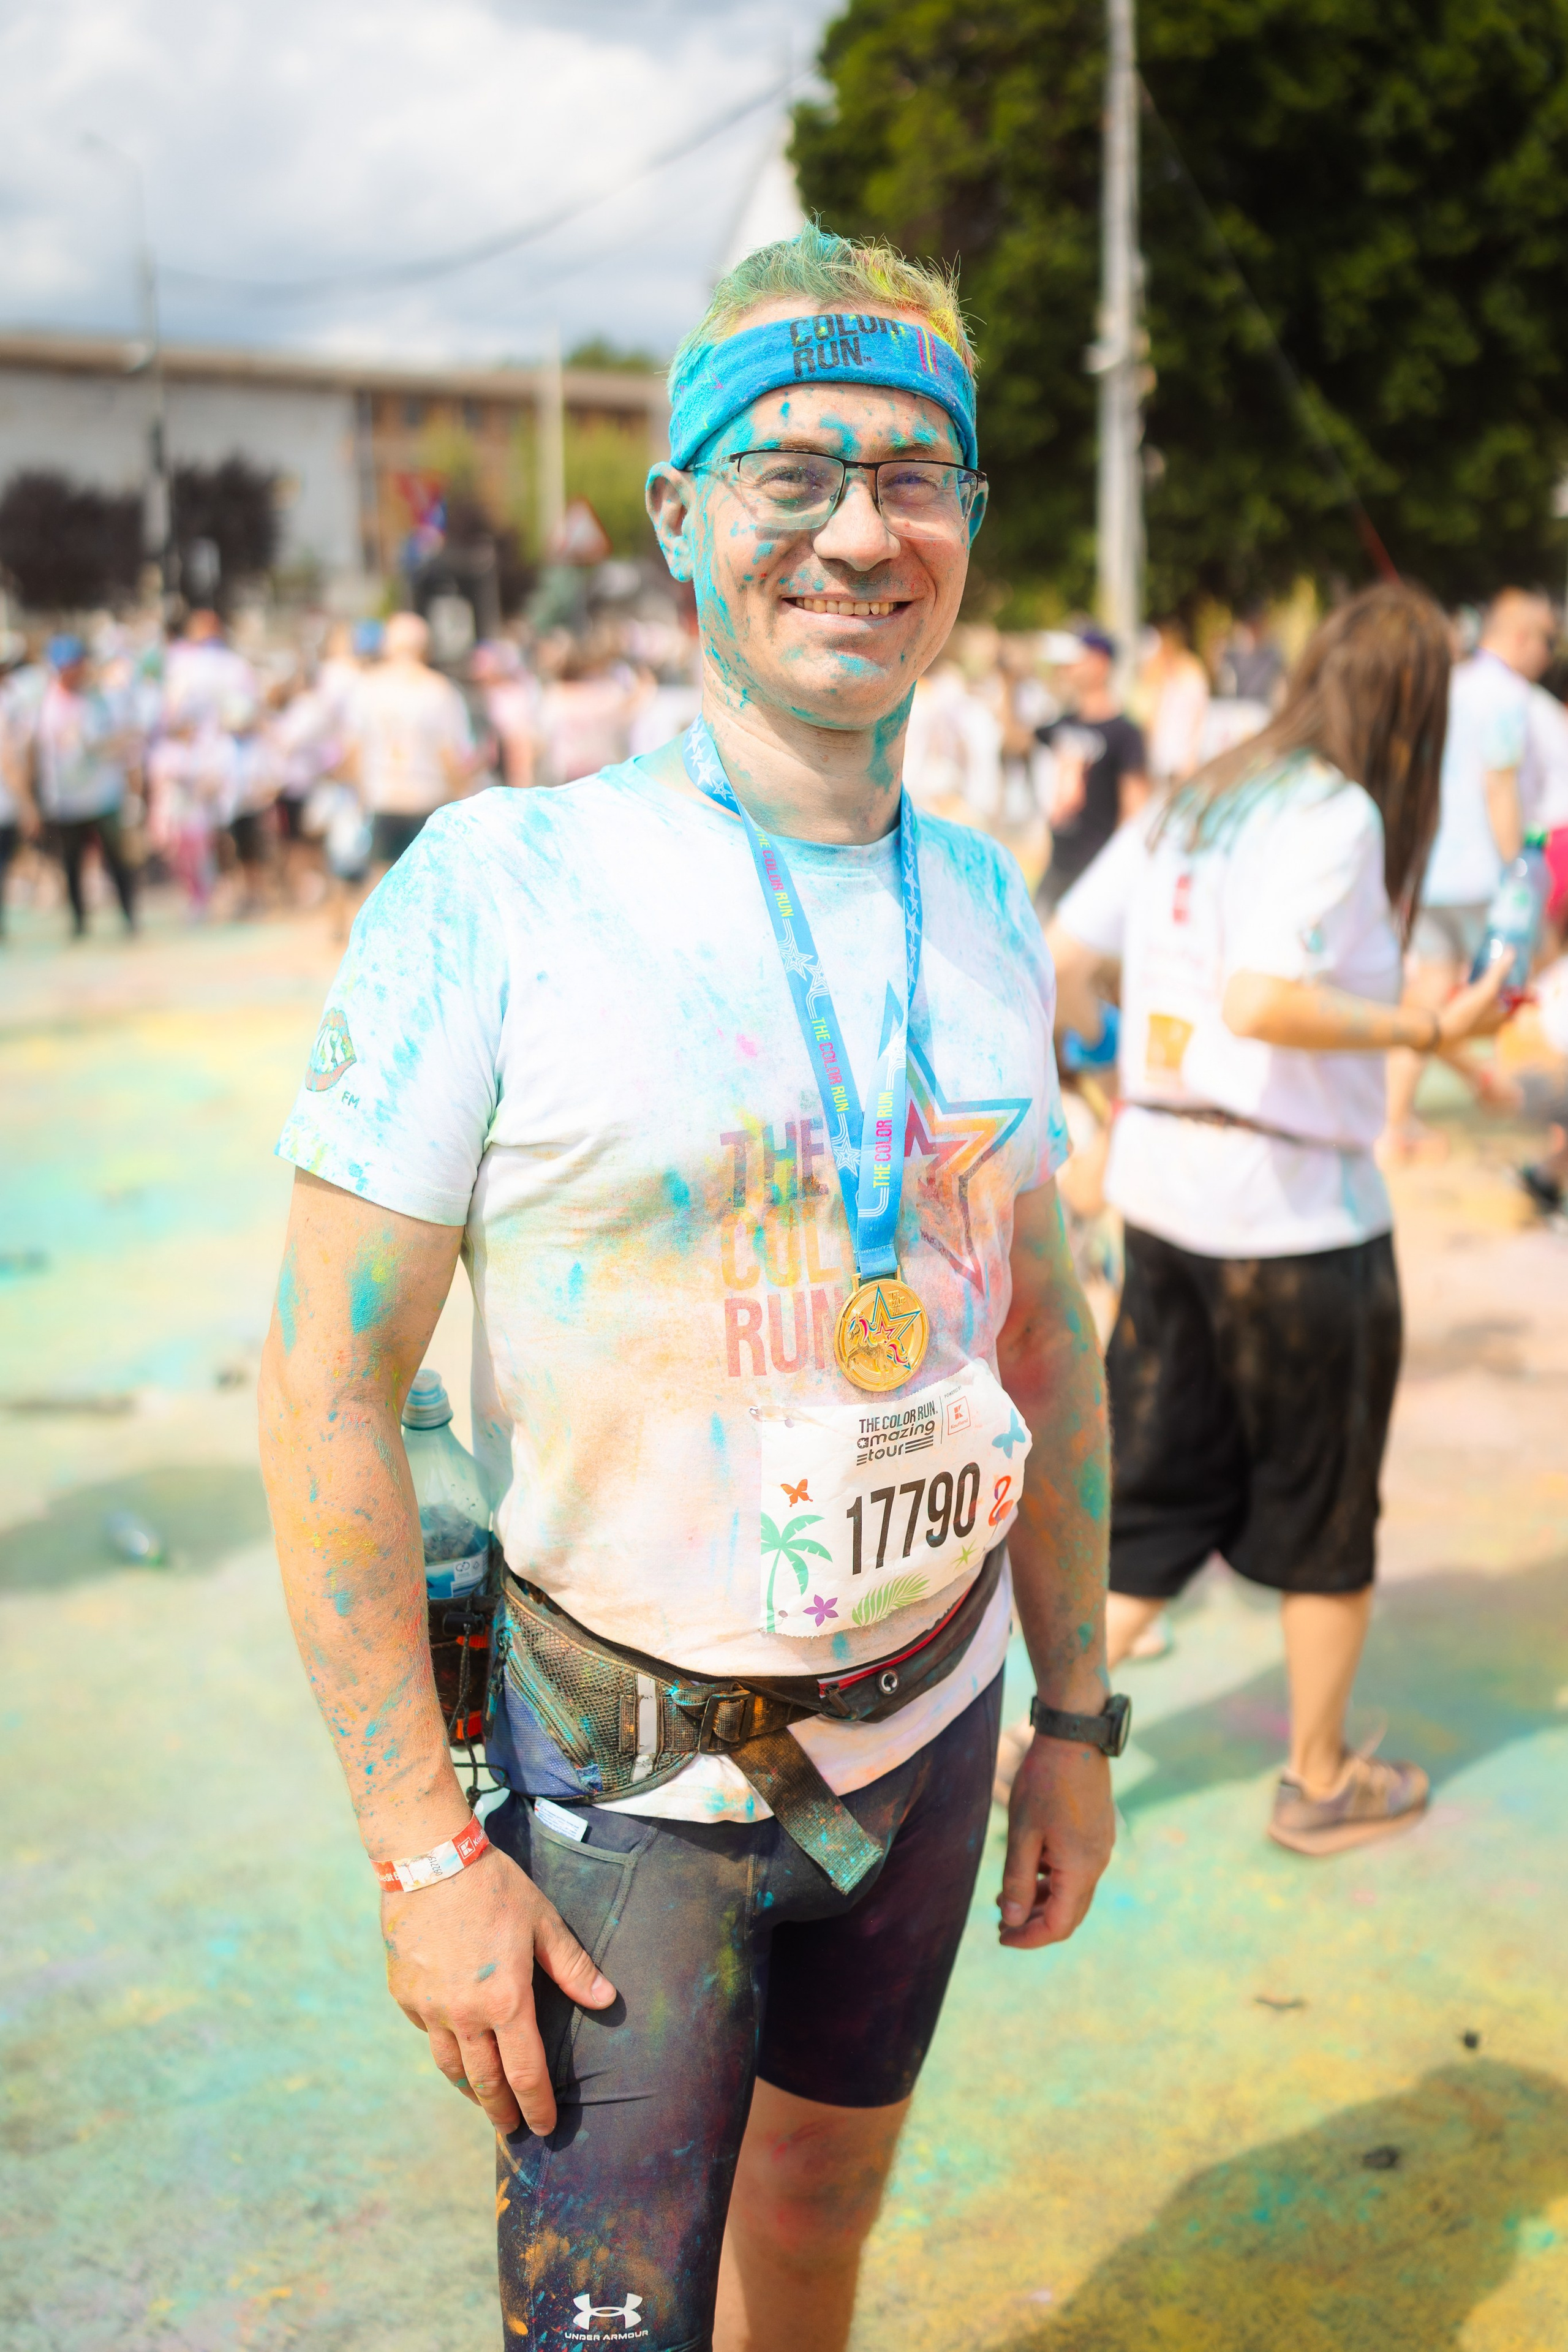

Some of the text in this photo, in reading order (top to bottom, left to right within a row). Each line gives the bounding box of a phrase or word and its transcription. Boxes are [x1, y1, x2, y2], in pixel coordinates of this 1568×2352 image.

[763, 850, 785, 891] COLOR
[775, 892, 794, 918] RUN
[812, 1017, 850, 1112] THE COLOR RUN
[342, 1091, 360, 1109] FM
[873, 1091, 894, 1188] THE COLOR RUN
[720, 1118, 829, 1208] THE
[859, 1417, 880, 1433] THE
[882, 1409, 916, 1429] COLOR
[951, 1418, 968, 1429] Kaufland
[857, 1420, 935, 1449] amazing
[868, 1444, 904, 1461] tour
[846, 1461, 980, 1575] 17790
[428, 1856, 443, 1876] 092715
[565, 2329, 649, 2341] UNDER ARMOUR
